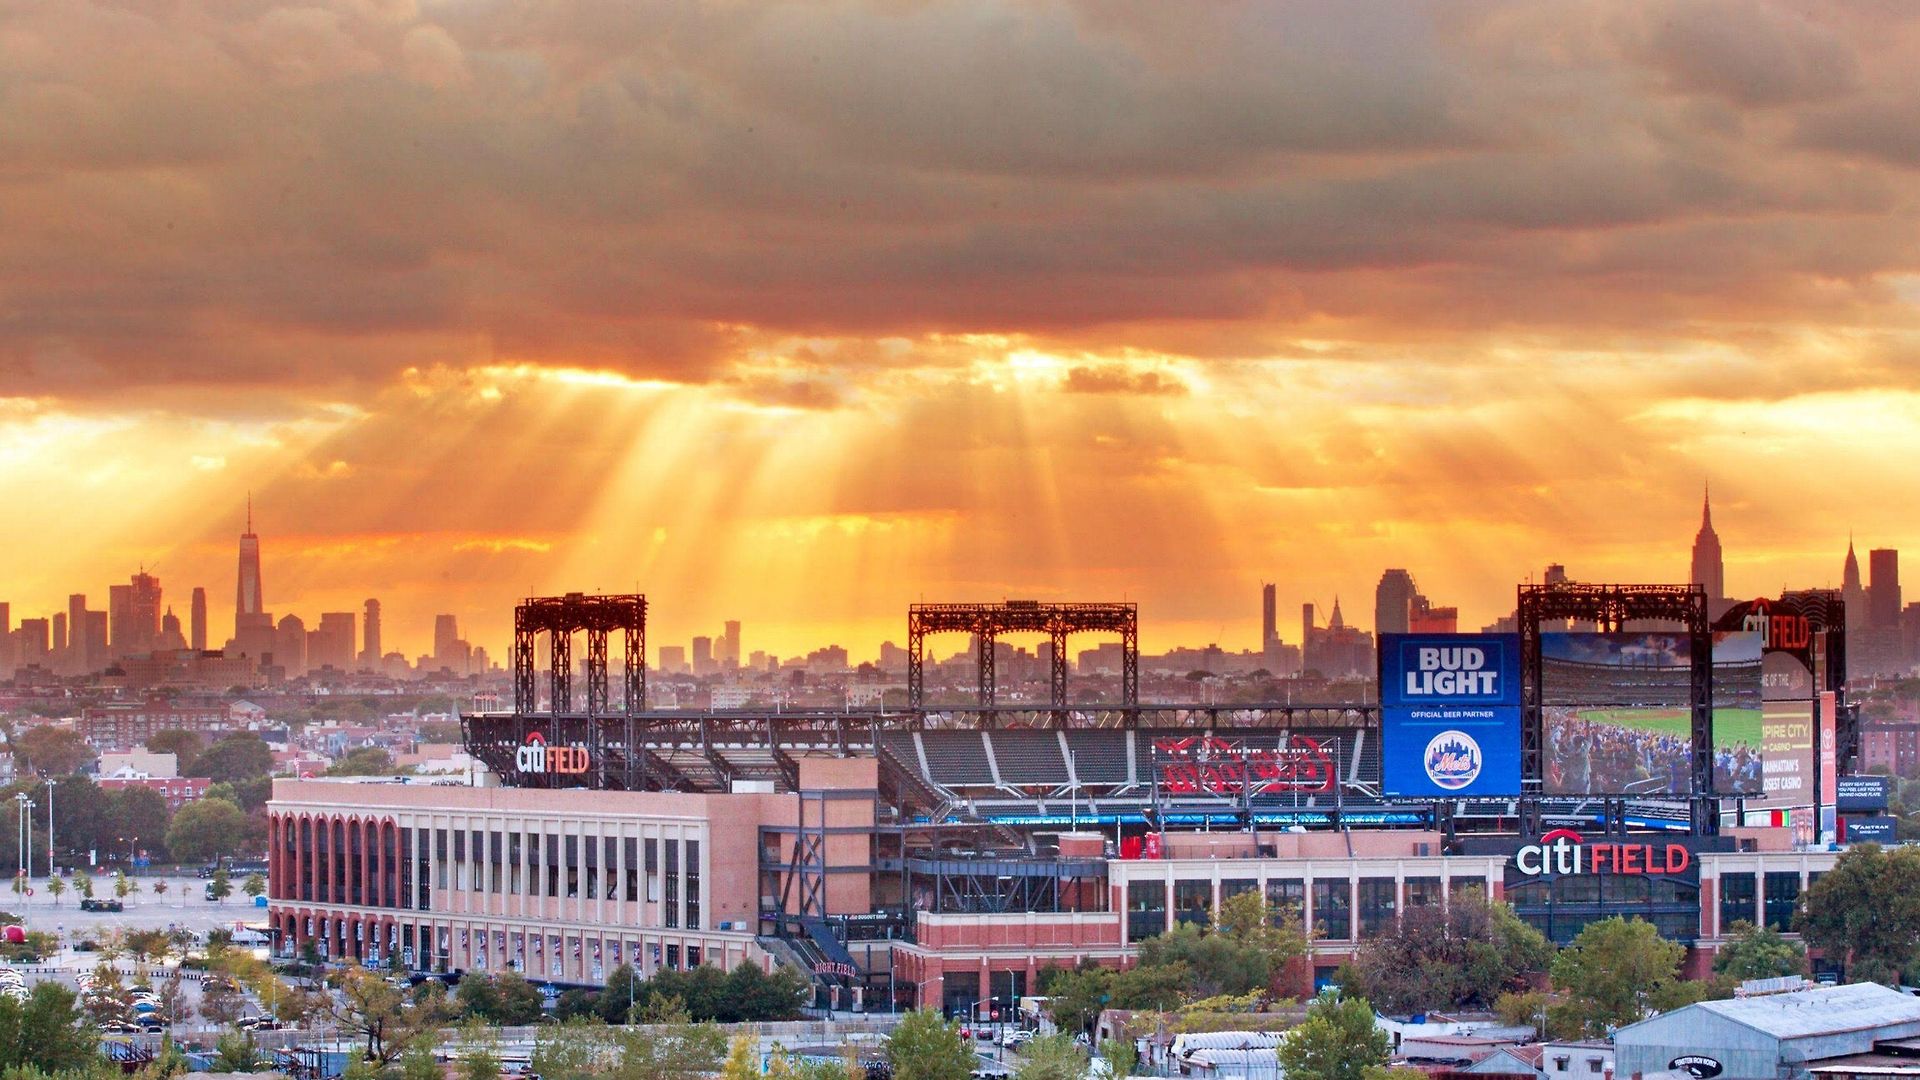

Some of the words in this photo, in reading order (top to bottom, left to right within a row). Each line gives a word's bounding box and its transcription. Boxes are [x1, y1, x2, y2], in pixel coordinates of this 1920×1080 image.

[1772, 615, 1808, 648] FIELD
[1419, 647, 1485, 671] BUD
[1406, 671, 1497, 695] LIGHT
[1411, 711, 1442, 719] OFFICIAL
[1443, 711, 1461, 719] BEER
[1462, 711, 1494, 719] PARTNER
[1763, 724, 1786, 738] PIRE
[1787, 724, 1808, 738] CITY
[516, 739, 545, 773] citi
[546, 746, 590, 774] FIELD
[1769, 743, 1791, 752] CASINO
[1434, 752, 1472, 772] Mets
[1781, 776, 1802, 790] CASINO
[1516, 836, 1582, 875] citi
[1591, 844, 1689, 874] FIELD
[815, 962, 835, 974] RIGHT
[836, 962, 856, 977] FIELD
